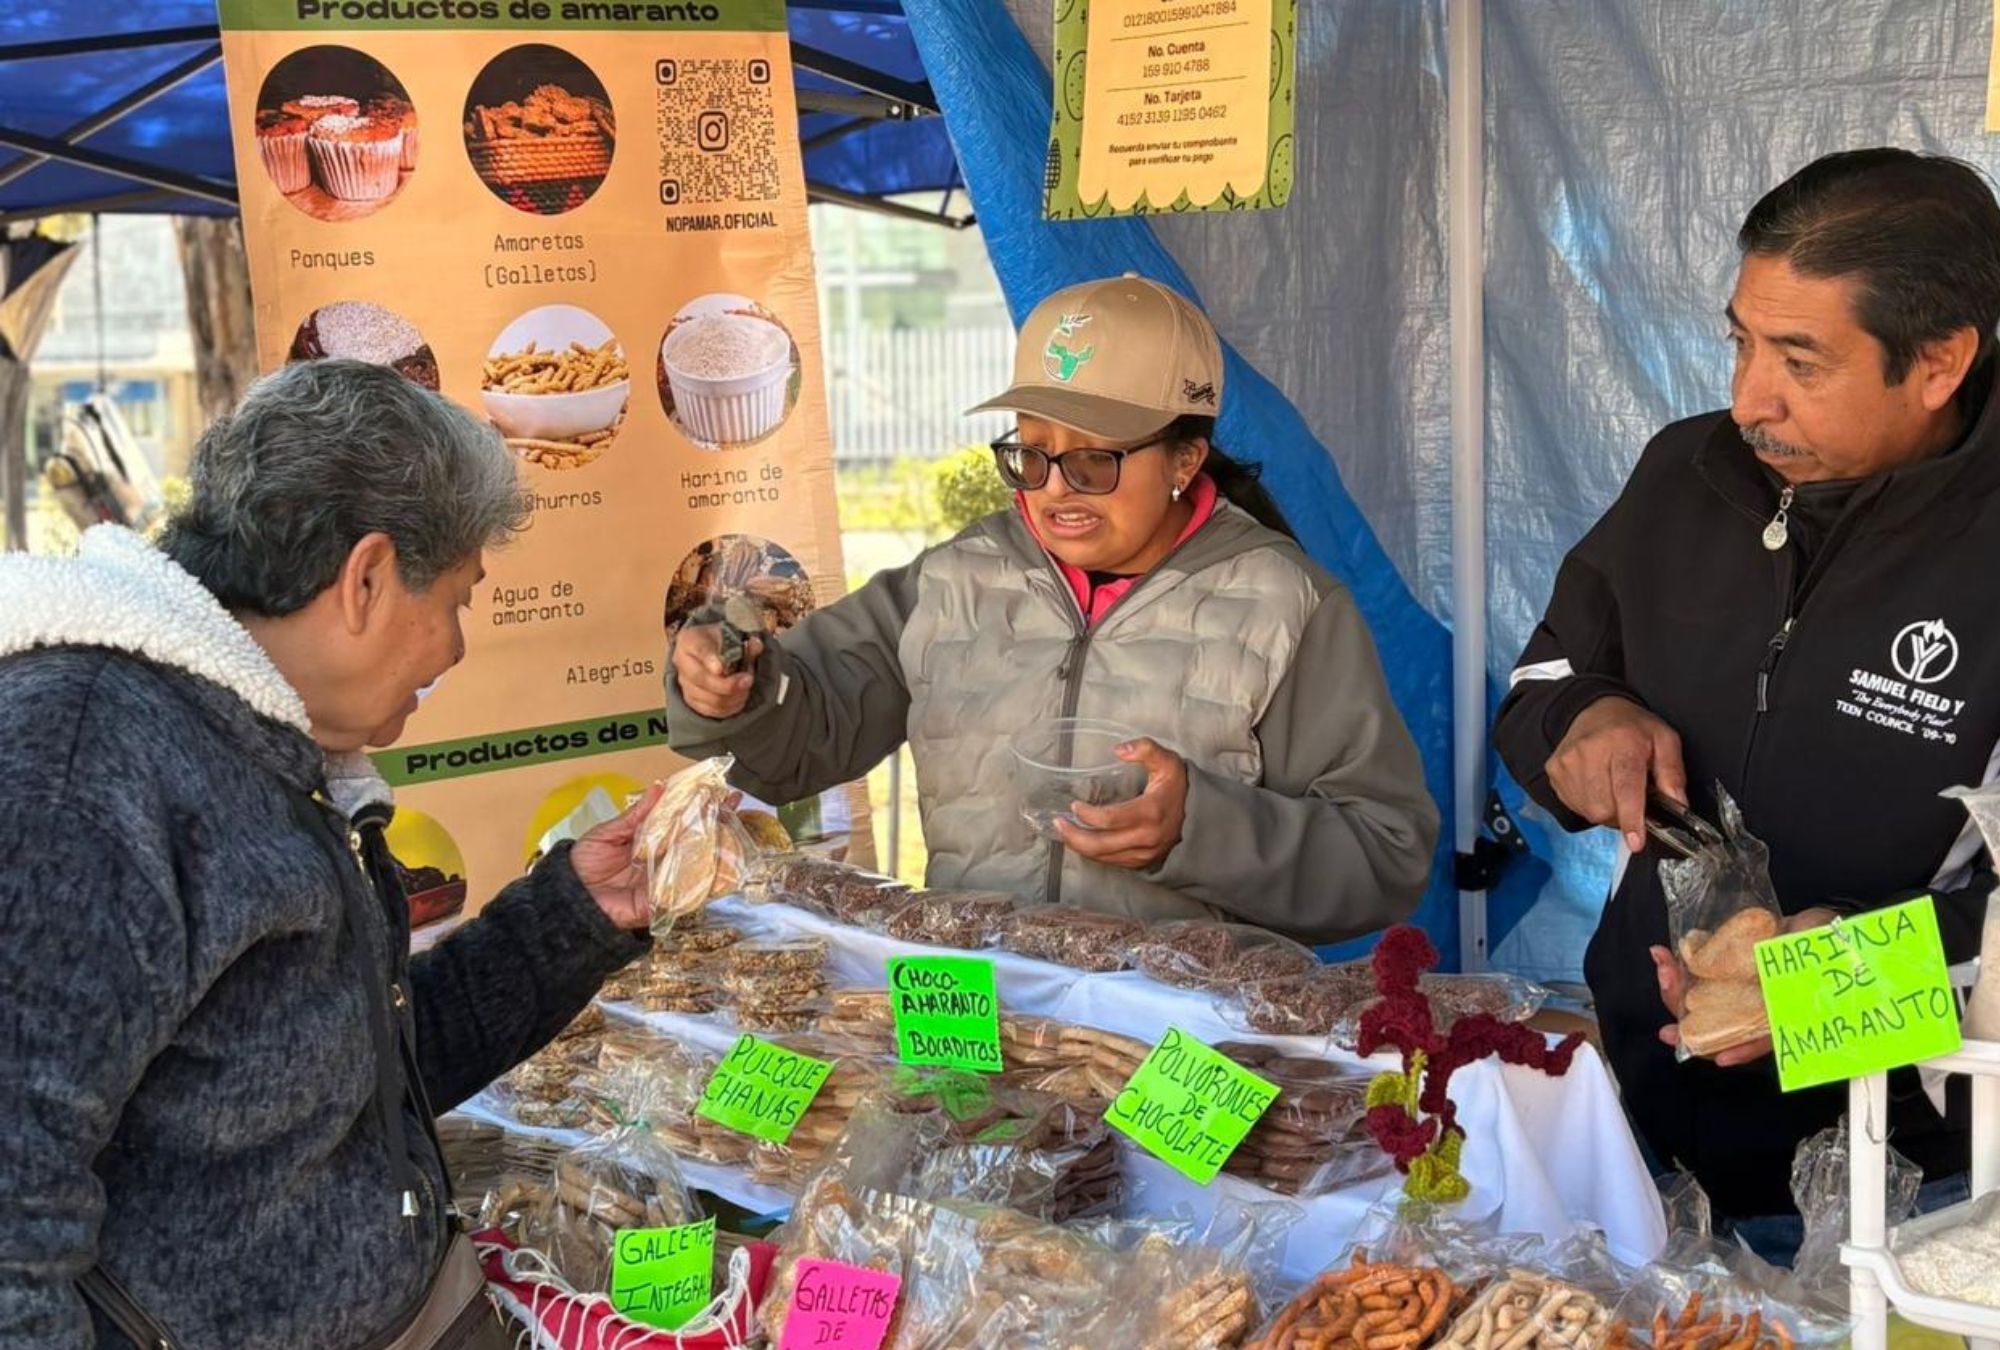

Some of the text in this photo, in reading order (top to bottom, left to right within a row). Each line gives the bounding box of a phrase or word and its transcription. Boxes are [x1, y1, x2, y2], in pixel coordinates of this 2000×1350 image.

[297, 0, 720, 21] Productos de amaranto
[1167, 41, 1206, 56] Cuenta
[1143, 58, 1210, 78] 159 910 4788
[1144, 89, 1202, 105] No. Tarjeta
[1199, 105, 1227, 120] 0462
[1108, 143, 1145, 153] Recuerda
[666, 210, 779, 232] NOPAMAR.OFICIAL
[493, 232, 584, 252] Amaretas
[290, 249, 375, 271] Panques
[680, 464, 784, 490] Harina de
[688, 485, 780, 510] amaranto
[492, 580, 574, 608] Agua de
[492, 601, 585, 626] amaranto
[566, 657, 655, 685] Alegrías
[1849, 669, 1966, 716] SAMUEL FIELD Y
[1836, 699, 1863, 718] TEEN
[1865, 709, 1915, 735] COUNCIL
[406, 731, 589, 774] Productos
[597, 721, 639, 743] de
[1760, 910, 1917, 978] HARINA
[893, 963, 959, 991] CHOCO-
[1821, 962, 1877, 997] DE
[1778, 986, 1950, 1072] AMARANTO
[908, 1030, 999, 1062] BOCADITOS
[730, 1034, 826, 1091] PULQUE
[1150, 1027, 1270, 1123] POLVORONES
[704, 1072, 801, 1126] CHANAS
[1179, 1091, 1208, 1121] DE
[1114, 1086, 1229, 1167] CHOCOLATE
[796, 1265, 891, 1319] GALLETAS
[814, 1320, 847, 1345] DE
